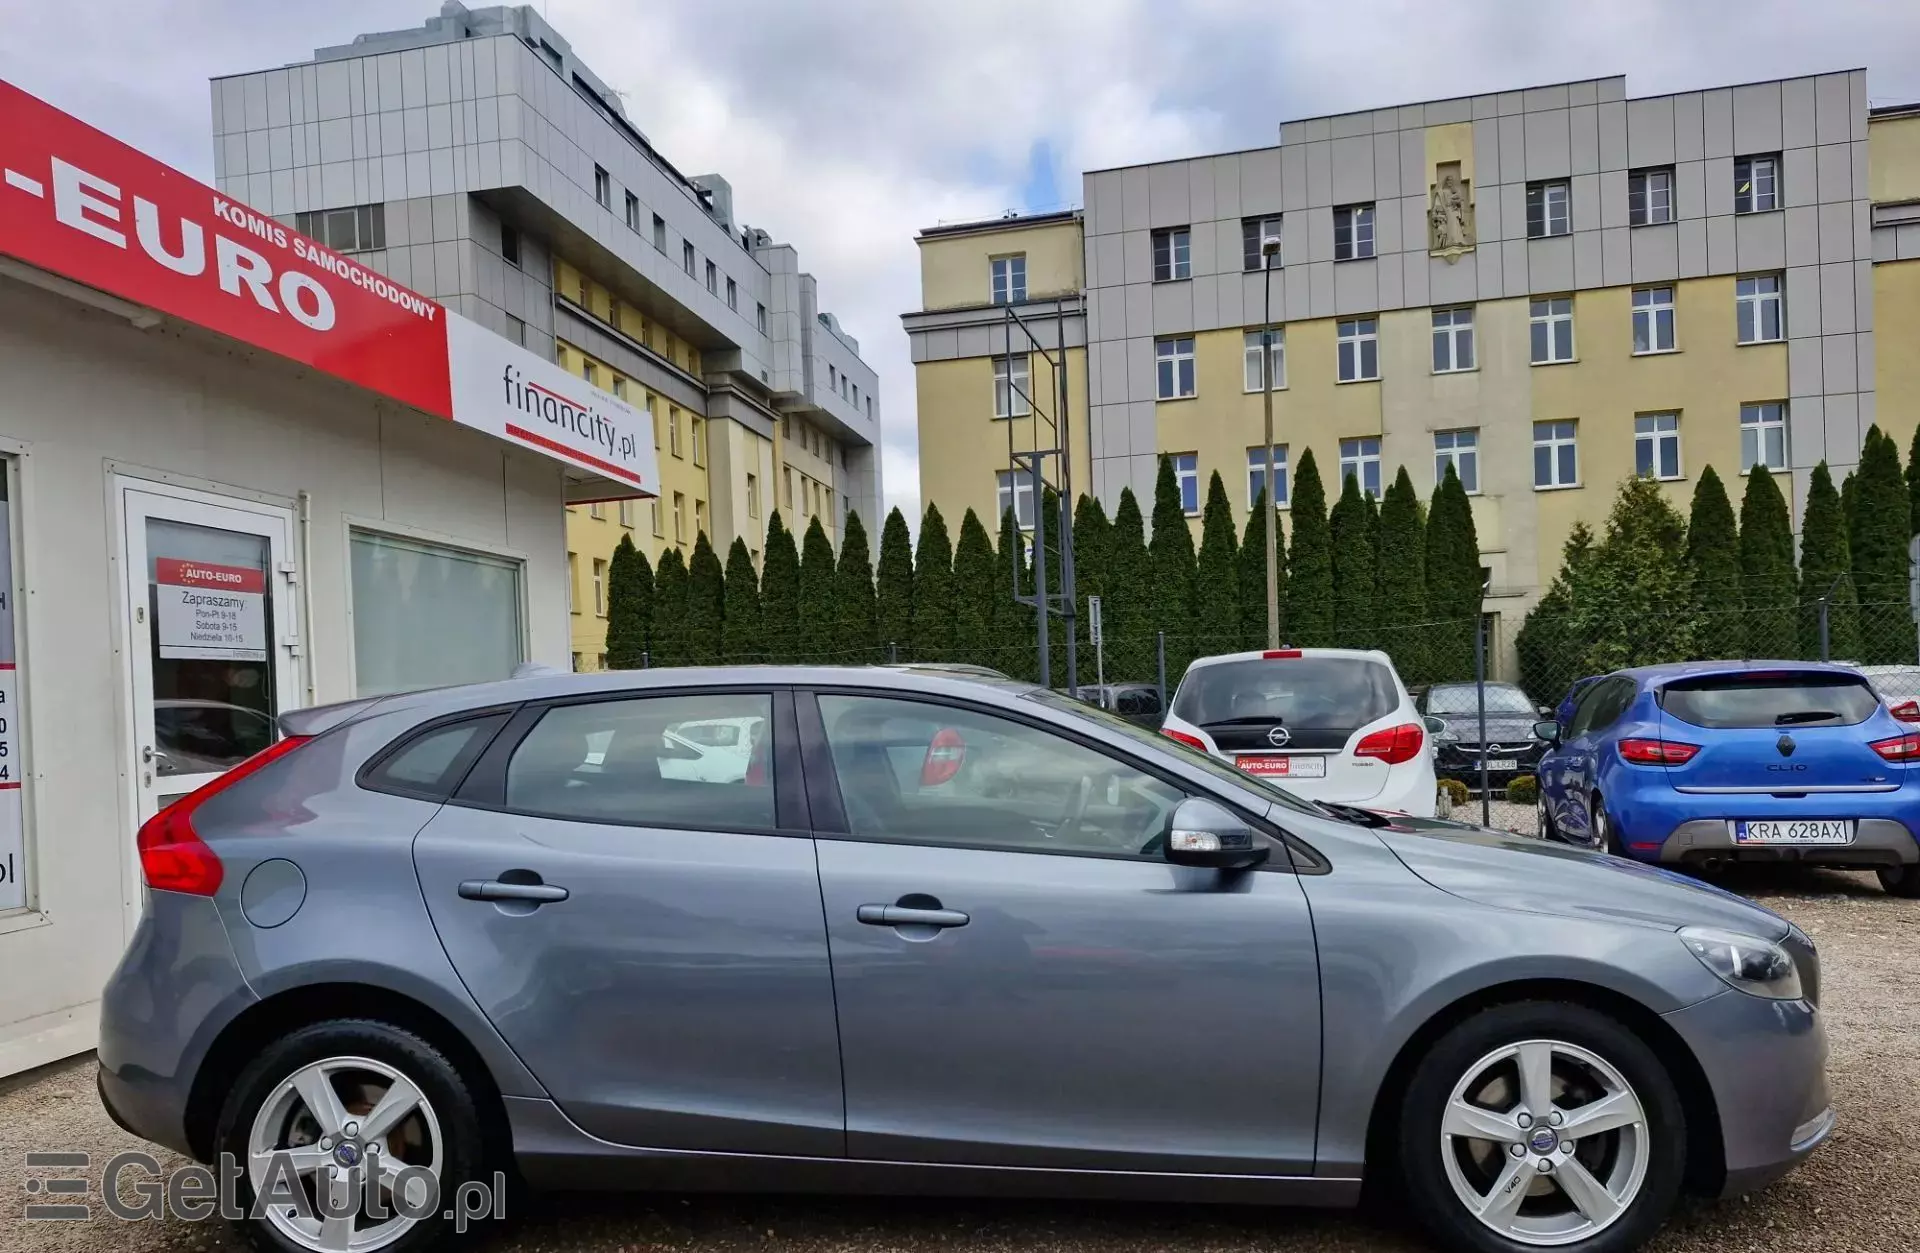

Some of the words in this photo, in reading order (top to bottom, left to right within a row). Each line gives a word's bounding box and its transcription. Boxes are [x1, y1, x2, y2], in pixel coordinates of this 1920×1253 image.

[213, 196, 287, 248] KOMIS
[293, 237, 436, 321] SAMOCHODOWY
[503, 364, 637, 460] financity.pl
[186, 568, 242, 583] AUTO-EURO
[196, 620, 220, 630] Sobota
[1766, 764, 1808, 772] CLIO
[1747, 822, 1782, 838] KRA
[1788, 822, 1843, 838] 628AX
[1504, 1175, 1521, 1194] V40
